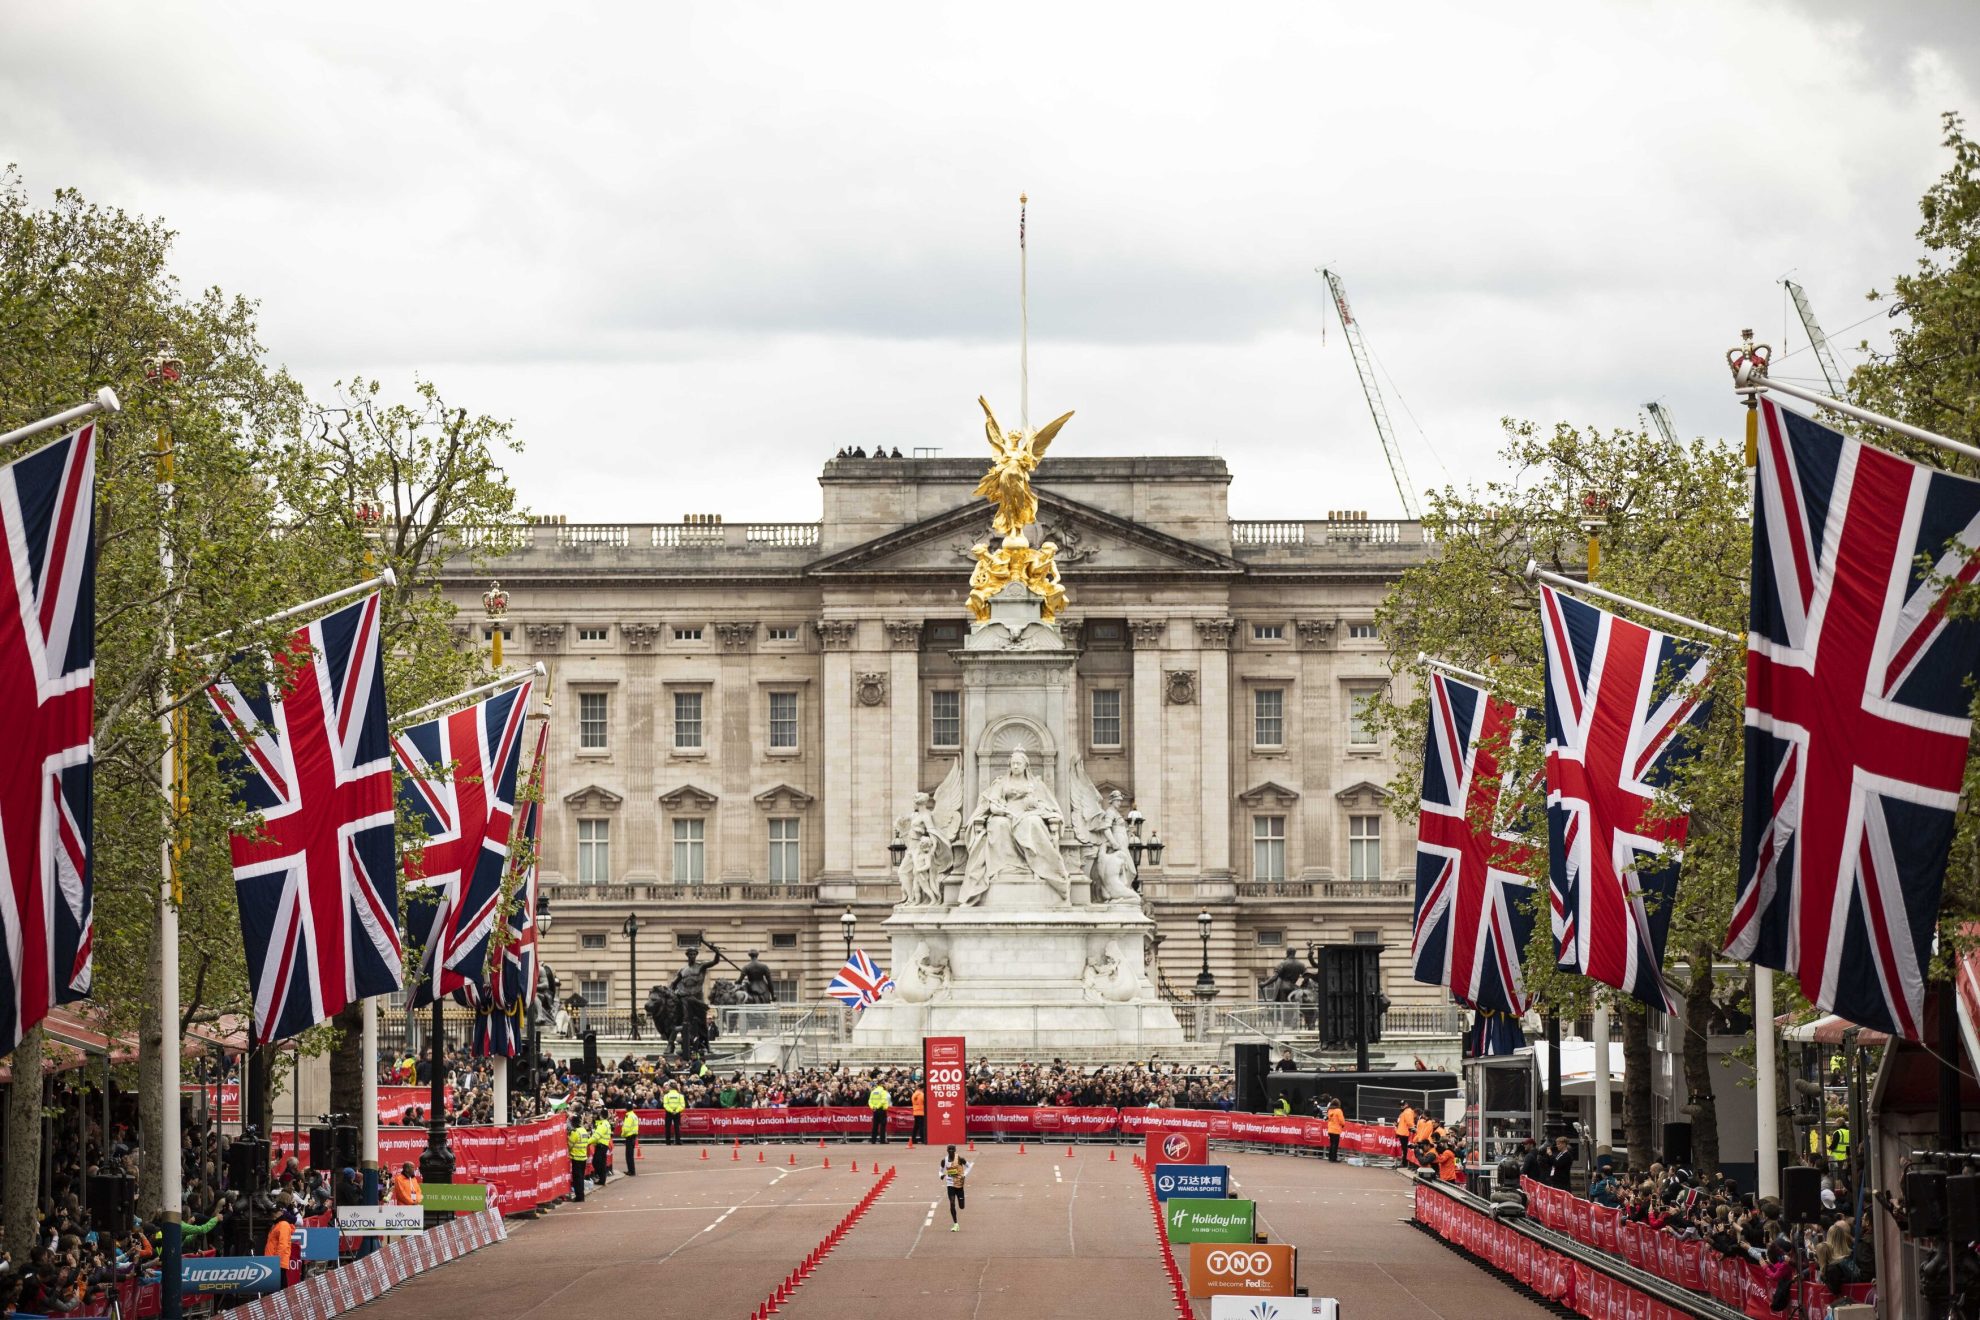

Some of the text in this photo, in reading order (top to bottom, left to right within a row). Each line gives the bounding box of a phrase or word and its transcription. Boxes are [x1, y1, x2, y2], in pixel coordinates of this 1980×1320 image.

[929, 1069, 962, 1083] 200
[712, 1117, 731, 1127] Virgin
[733, 1117, 755, 1127] Money
[757, 1116, 784, 1125] London
[832, 1115, 858, 1123] London
[971, 1114, 995, 1123] London
[997, 1114, 1029, 1123] Marathon
[1062, 1115, 1081, 1125] Virgin
[1082, 1115, 1105, 1124] Money
[1123, 1115, 1141, 1126] Virgin
[1142, 1116, 1162, 1126] Money
[1163, 1117, 1181, 1126] London
[1182, 1118, 1207, 1128] Marathon
[1232, 1122, 1245, 1133] Virgin
[1246, 1123, 1262, 1134] Money
[1263, 1124, 1280, 1133] London
[1281, 1126, 1301, 1135] Marathon
[379, 1139, 393, 1151] virgin
[394, 1140, 410, 1150] money
[1165, 1137, 1187, 1157] Virgin
[1178, 1176, 1221, 1185] 万达体育
[1192, 1214, 1246, 1227] Holiday Inn
[182, 1266, 259, 1282] Lucozade
